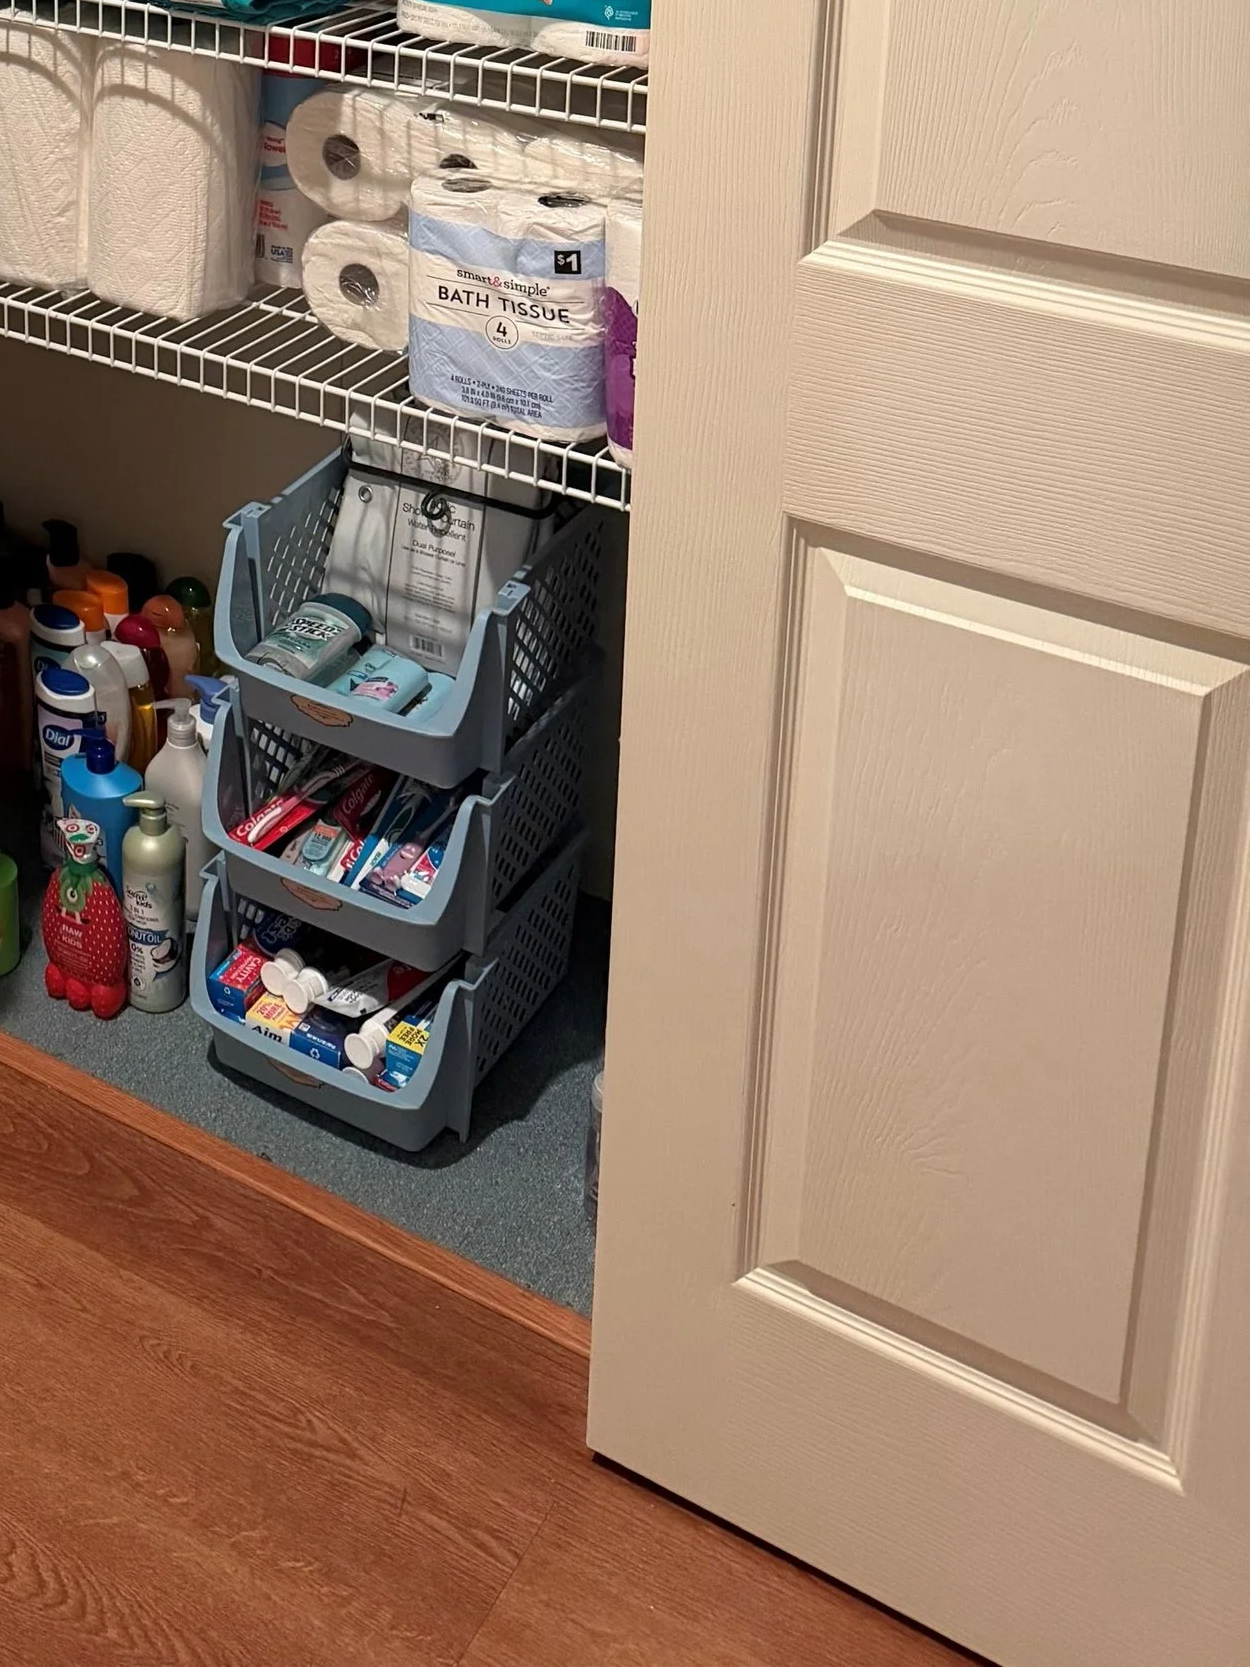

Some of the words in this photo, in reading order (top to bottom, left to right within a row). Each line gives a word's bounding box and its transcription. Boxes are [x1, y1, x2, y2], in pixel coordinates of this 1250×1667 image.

[557, 253, 578, 272] $1
[438, 285, 490, 309] BATH
[498, 296, 570, 324] TISSUE
[496, 322, 508, 338] 4
[506, 387, 527, 398] SHEETS
[290, 624, 327, 640] STICK
[294, 617, 336, 633] SPEED
[46, 728, 70, 747] Dial
[61, 924, 83, 938] RAW
[61, 935, 83, 949] KIDS
[251, 1025, 283, 1042] Aim
